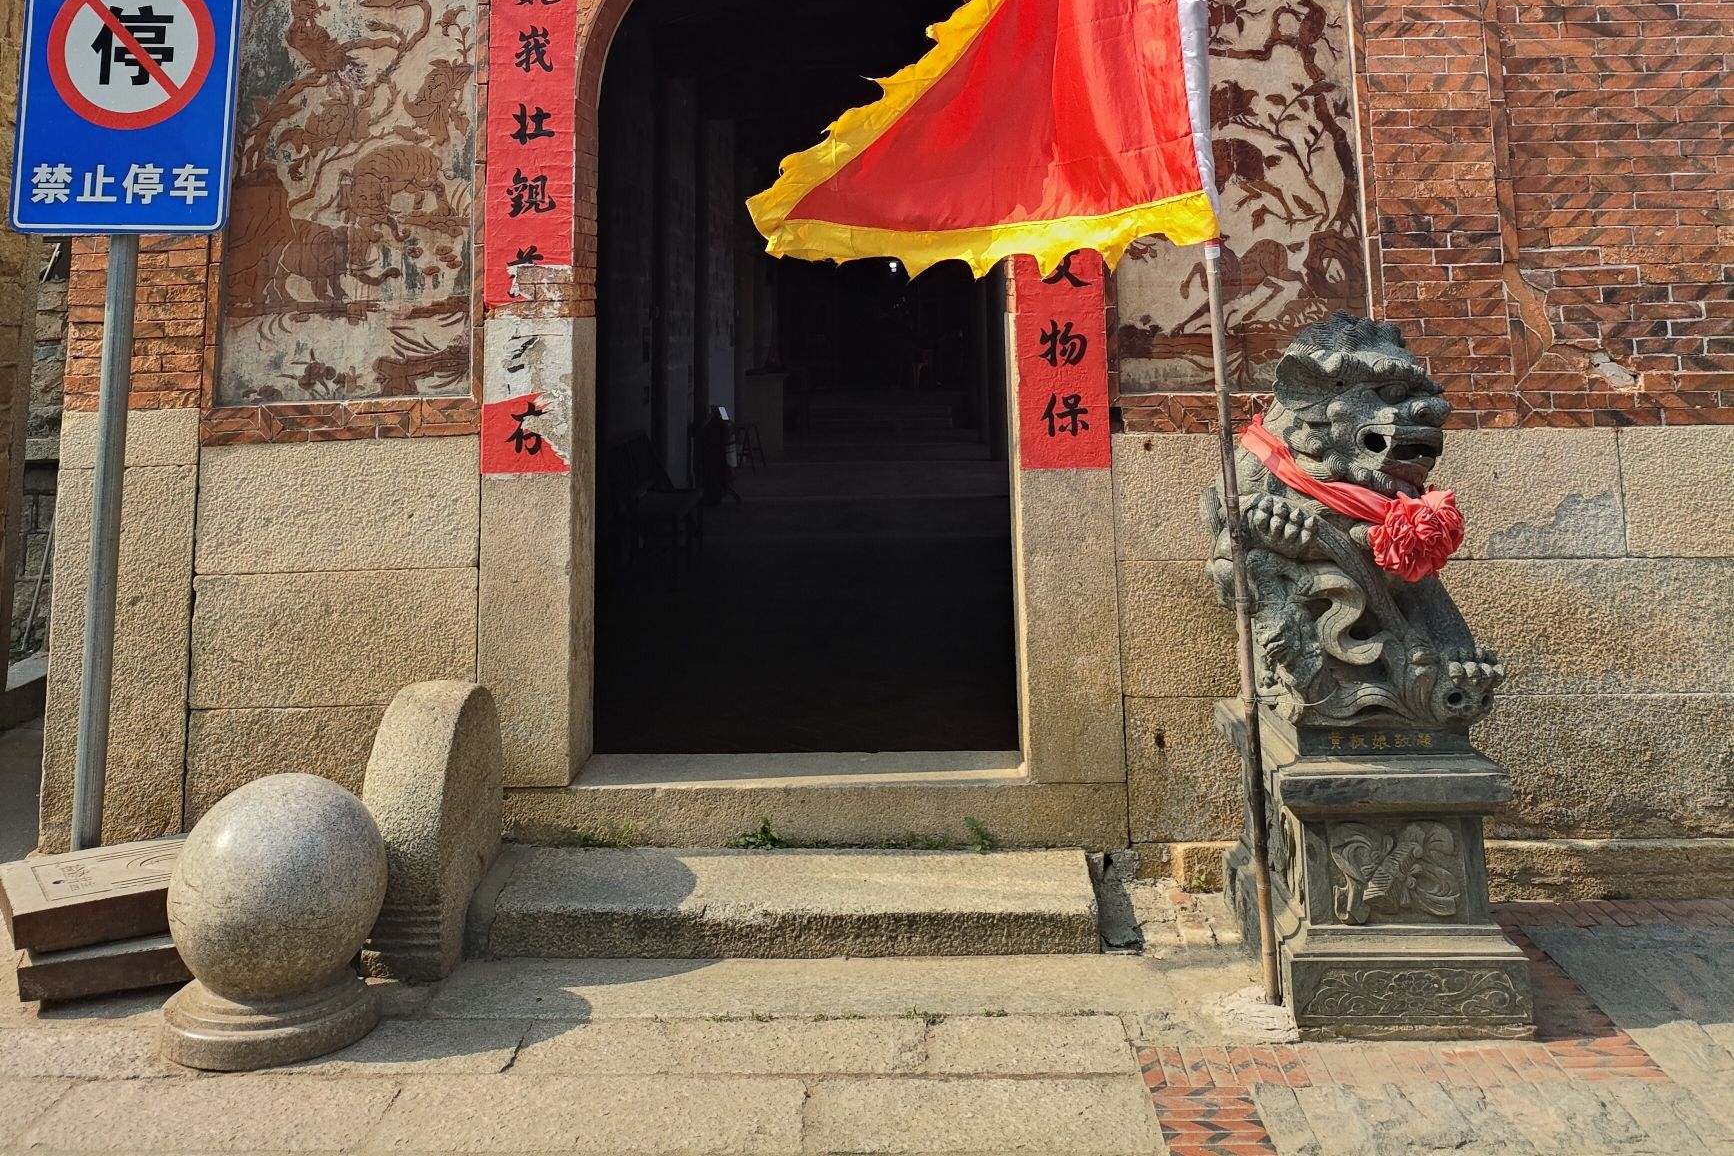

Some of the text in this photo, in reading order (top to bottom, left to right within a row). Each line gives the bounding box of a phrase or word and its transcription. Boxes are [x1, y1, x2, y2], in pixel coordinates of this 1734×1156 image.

[91, 5, 174, 86] 停
[31, 163, 209, 205] 禁止停车
